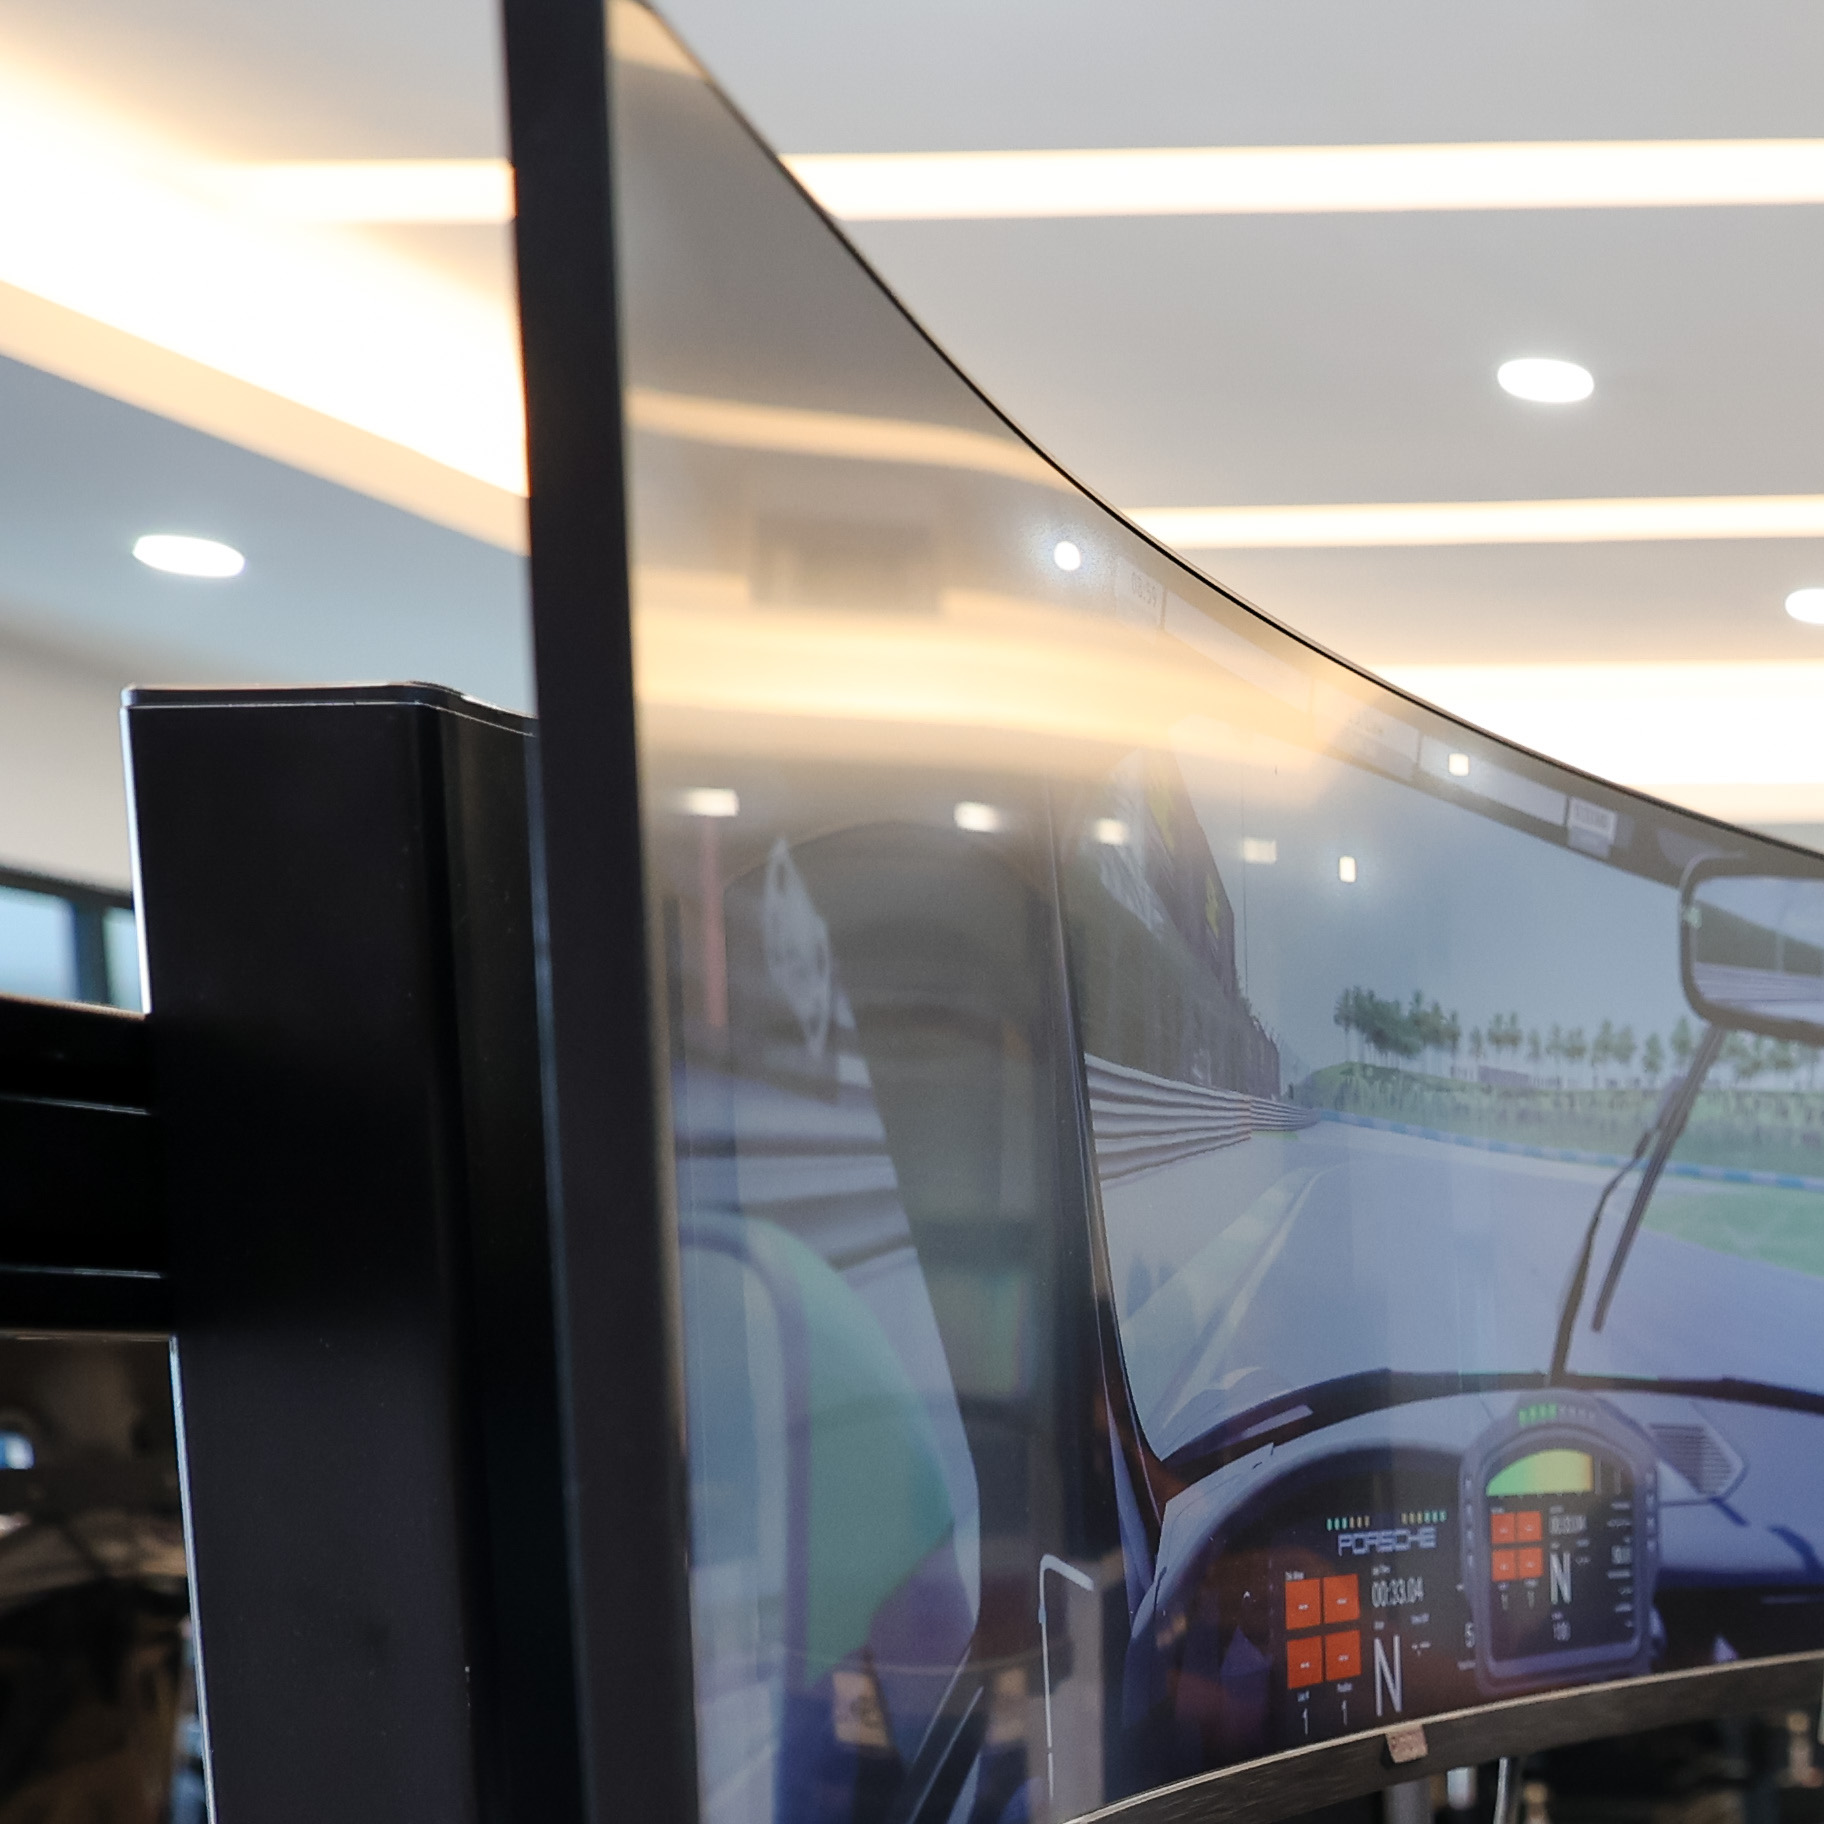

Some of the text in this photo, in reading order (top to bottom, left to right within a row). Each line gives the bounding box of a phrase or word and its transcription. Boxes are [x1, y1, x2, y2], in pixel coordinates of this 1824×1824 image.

[1337, 1526, 1438, 1557] PORSCHE
[1550, 1551, 1573, 1605] N
[1374, 1634, 1403, 1718] N
